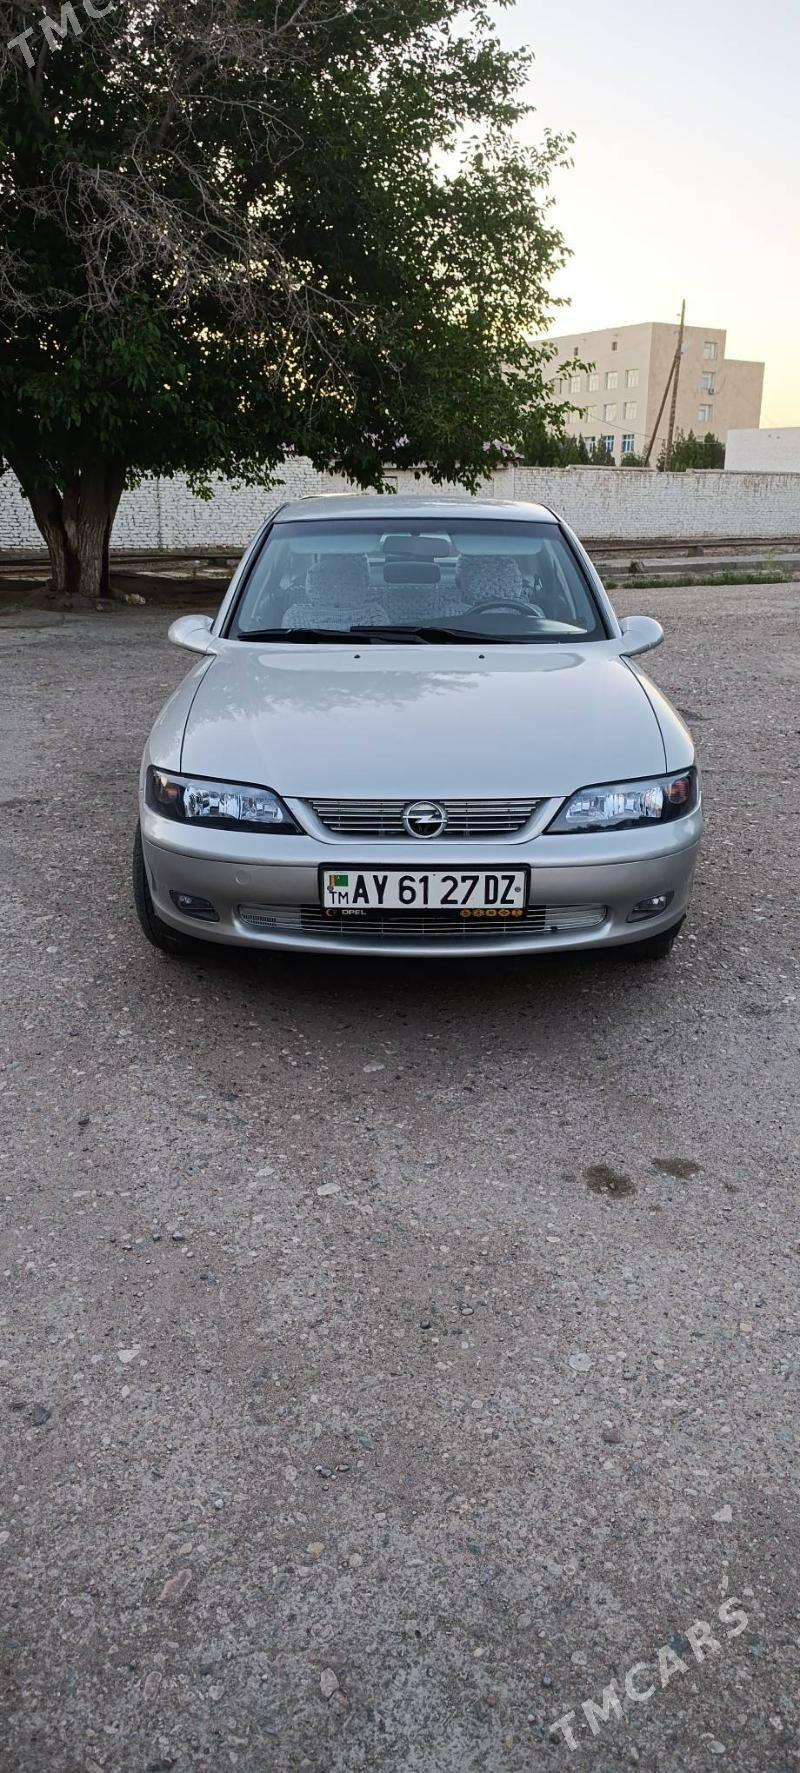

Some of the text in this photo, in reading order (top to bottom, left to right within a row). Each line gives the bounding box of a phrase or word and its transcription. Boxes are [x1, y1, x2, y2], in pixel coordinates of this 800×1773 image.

[329, 891, 349, 905] TM
[352, 875, 516, 905] AY 61 27 DZ
